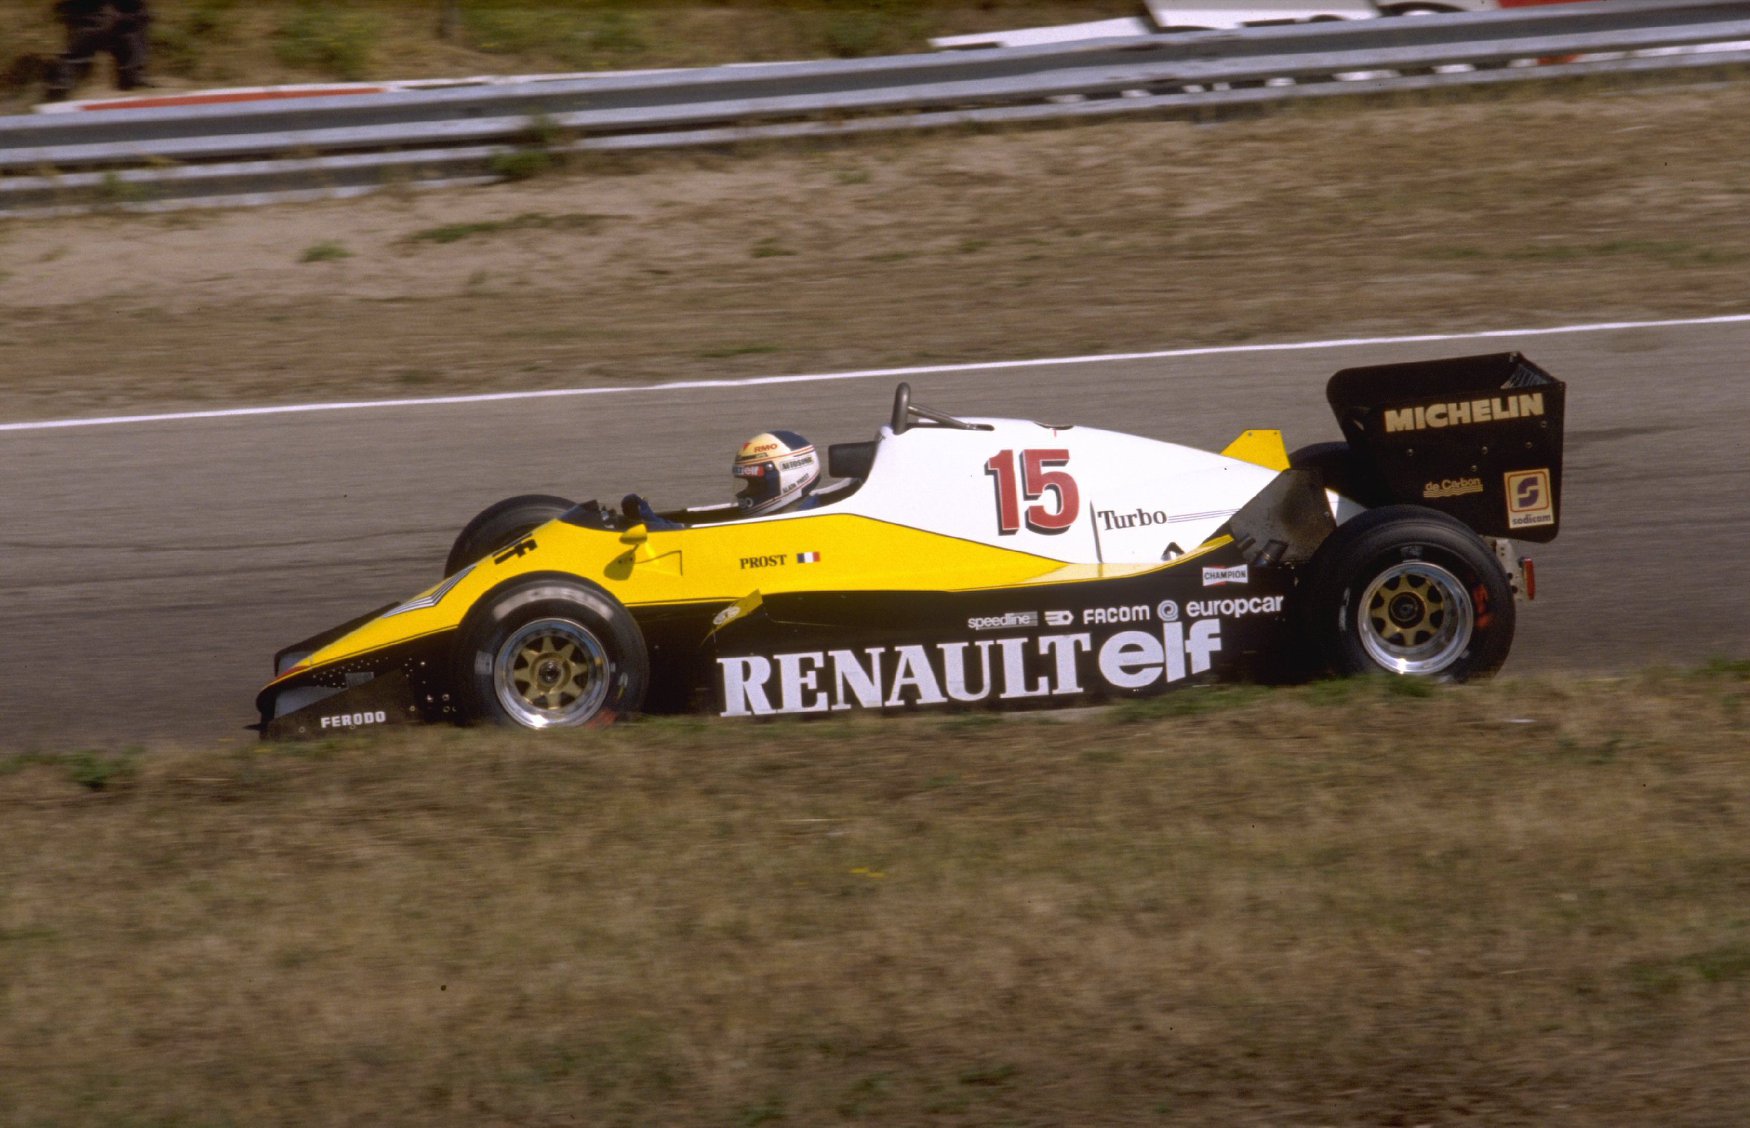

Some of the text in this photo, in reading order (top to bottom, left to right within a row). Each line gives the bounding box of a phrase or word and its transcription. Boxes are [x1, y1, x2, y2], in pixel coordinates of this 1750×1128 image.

[1384, 393, 1545, 433] MICHELIN
[984, 448, 1080, 536] 15
[1441, 477, 1481, 490] Carbon
[1097, 508, 1167, 531] Turbo
[1512, 513, 1551, 526] sodicam
[740, 554, 787, 570] PROST
[1203, 570, 1247, 581] CHAMPION
[1083, 604, 1150, 625] FACOM
[1186, 595, 1284, 618] europcar
[967, 612, 1031, 630] speedline
[1098, 618, 1222, 689] elf
[716, 632, 1091, 718] RENAULT
[320, 711, 386, 728] FERODO
